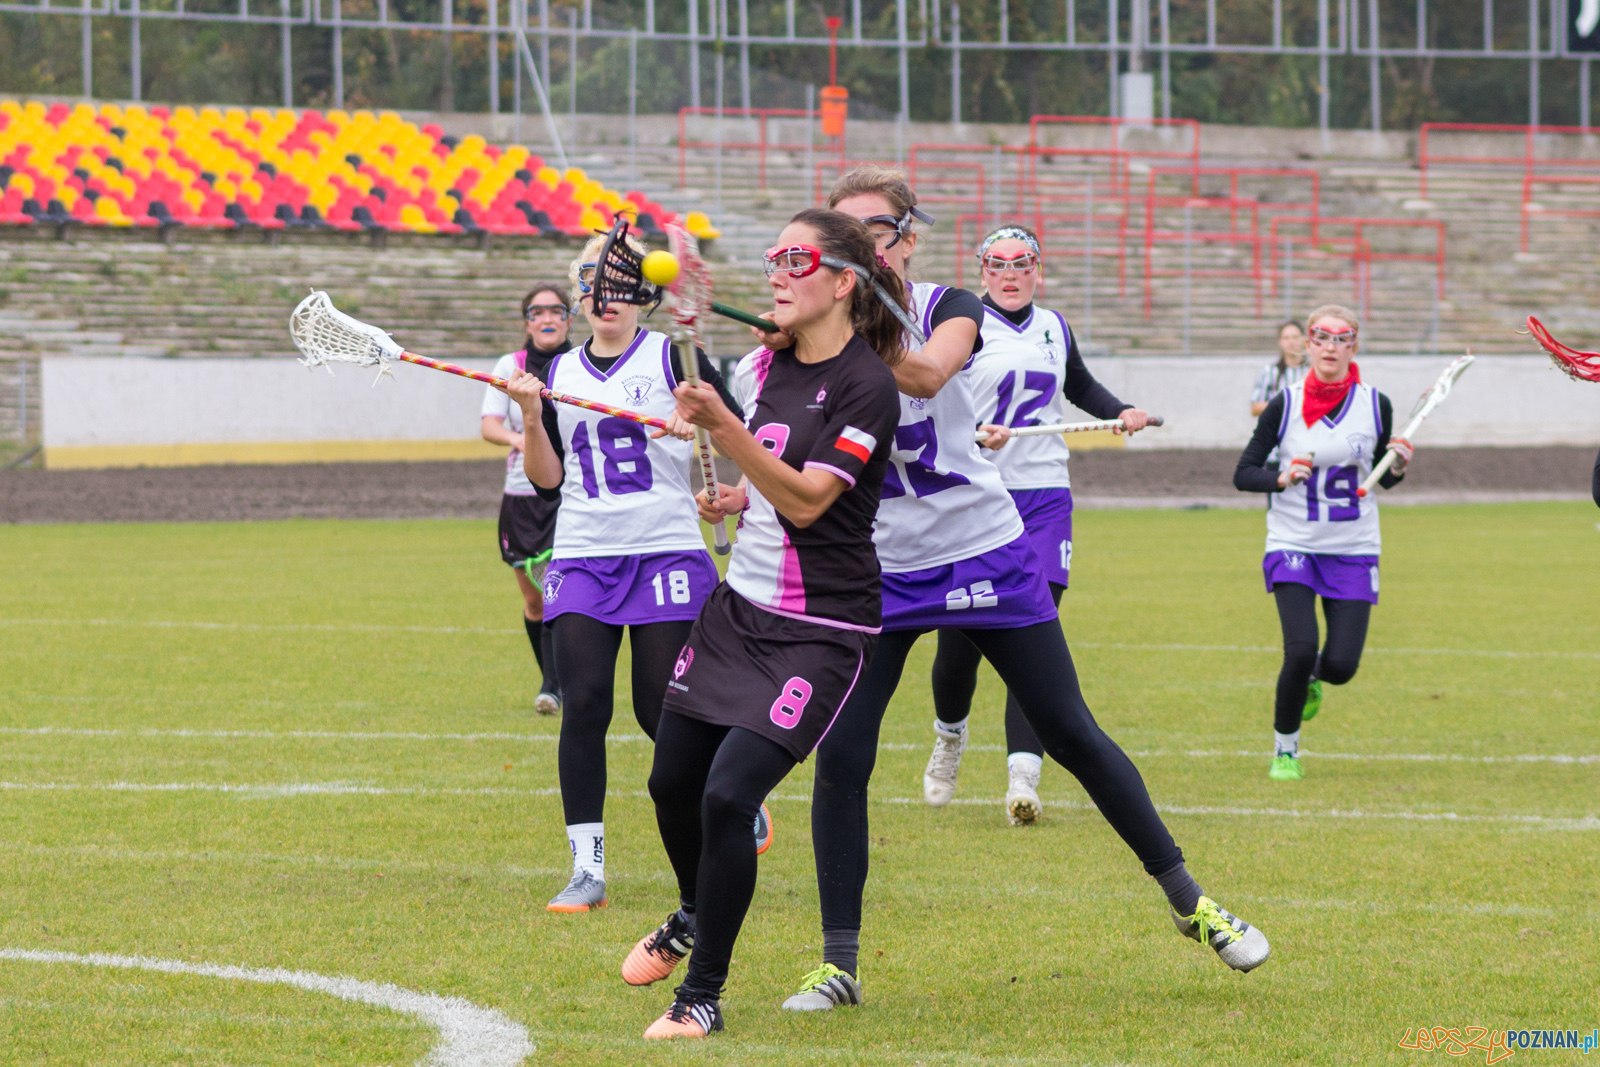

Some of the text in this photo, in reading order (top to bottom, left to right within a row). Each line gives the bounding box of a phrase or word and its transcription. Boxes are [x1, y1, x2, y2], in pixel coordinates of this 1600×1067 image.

[992, 370, 1057, 428] 12
[571, 415, 653, 499] 18
[699, 443, 717, 497] CANADA
[1303, 464, 1361, 522] 19
[652, 570, 691, 606] 18
[769, 676, 813, 730] 8
